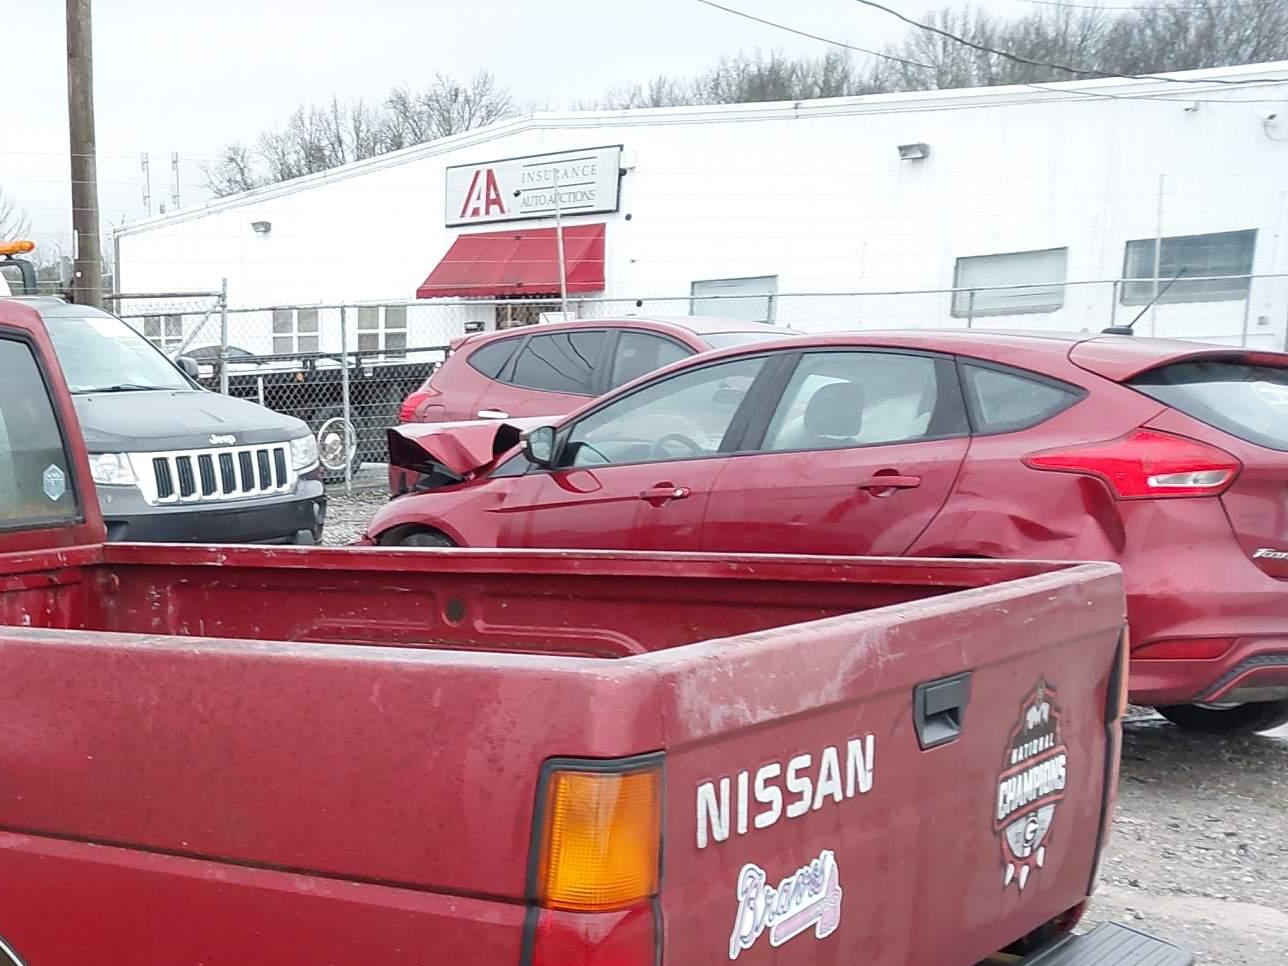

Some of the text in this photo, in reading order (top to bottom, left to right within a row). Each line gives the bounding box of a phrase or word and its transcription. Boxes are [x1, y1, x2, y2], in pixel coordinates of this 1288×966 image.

[521, 164, 598, 183] INSURANCE
[521, 191, 547, 208] AUTO
[696, 733, 875, 849] NISSAN
[997, 754, 1067, 820] CHAMPIONS
